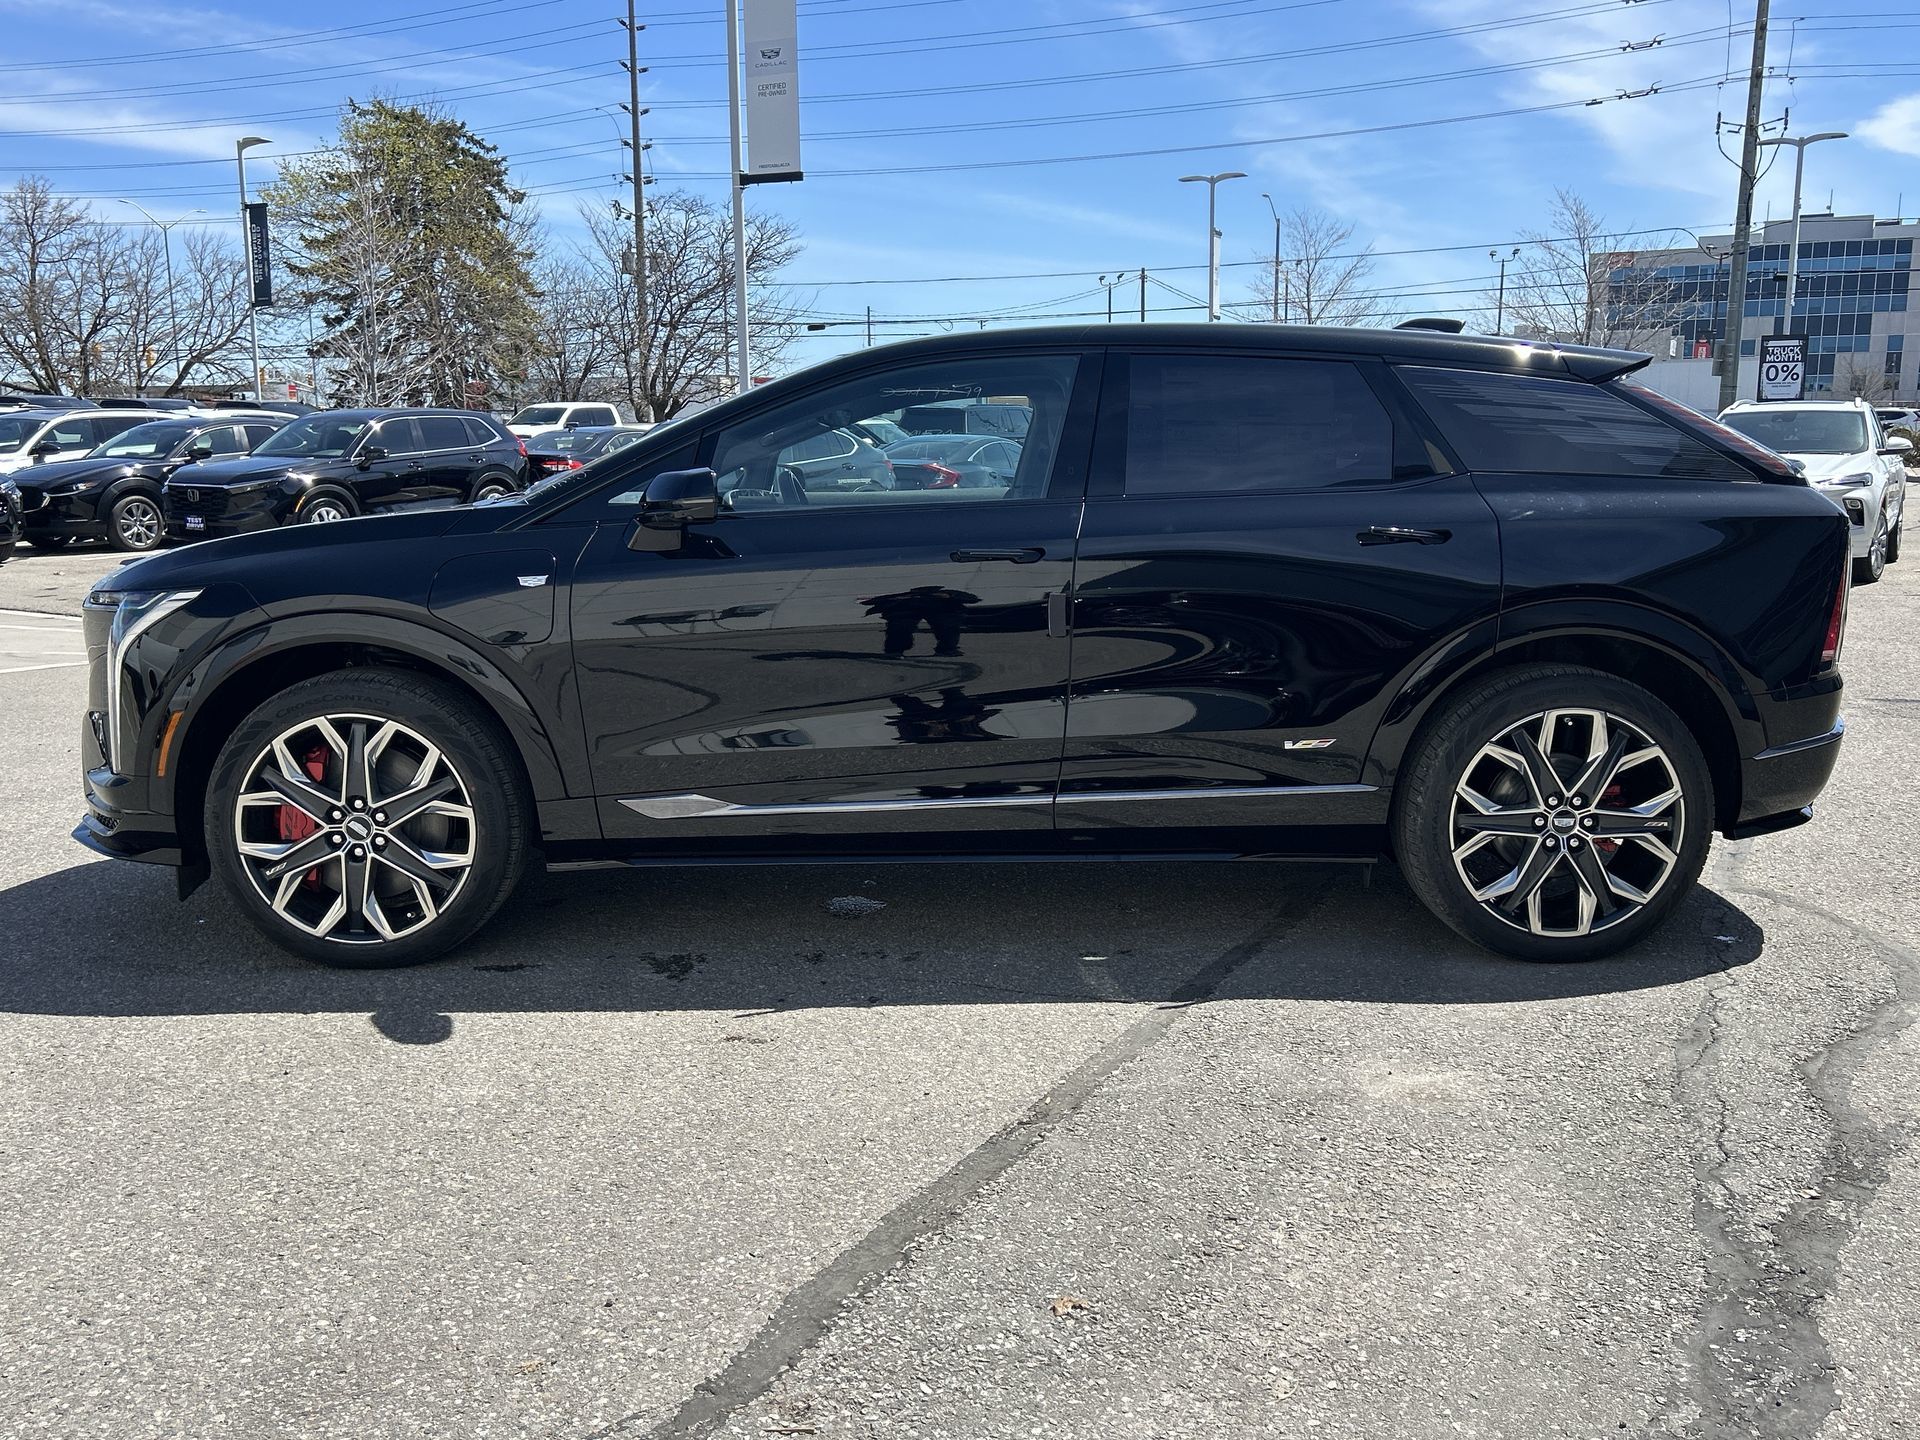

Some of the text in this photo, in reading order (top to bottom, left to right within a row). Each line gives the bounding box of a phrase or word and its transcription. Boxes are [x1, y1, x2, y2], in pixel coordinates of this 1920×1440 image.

[755, 60, 788, 68] CADILLAC
[757, 82, 787, 91] CERTIFIED
[757, 89, 787, 97] PRE-OWNED
[1767, 346, 1801, 355] TRUCK
[1765, 353, 1802, 362] MONTH
[1765, 363, 1800, 382] 0%
[186, 516, 203, 524] TEST
[185, 522, 204, 530] DRIVE
